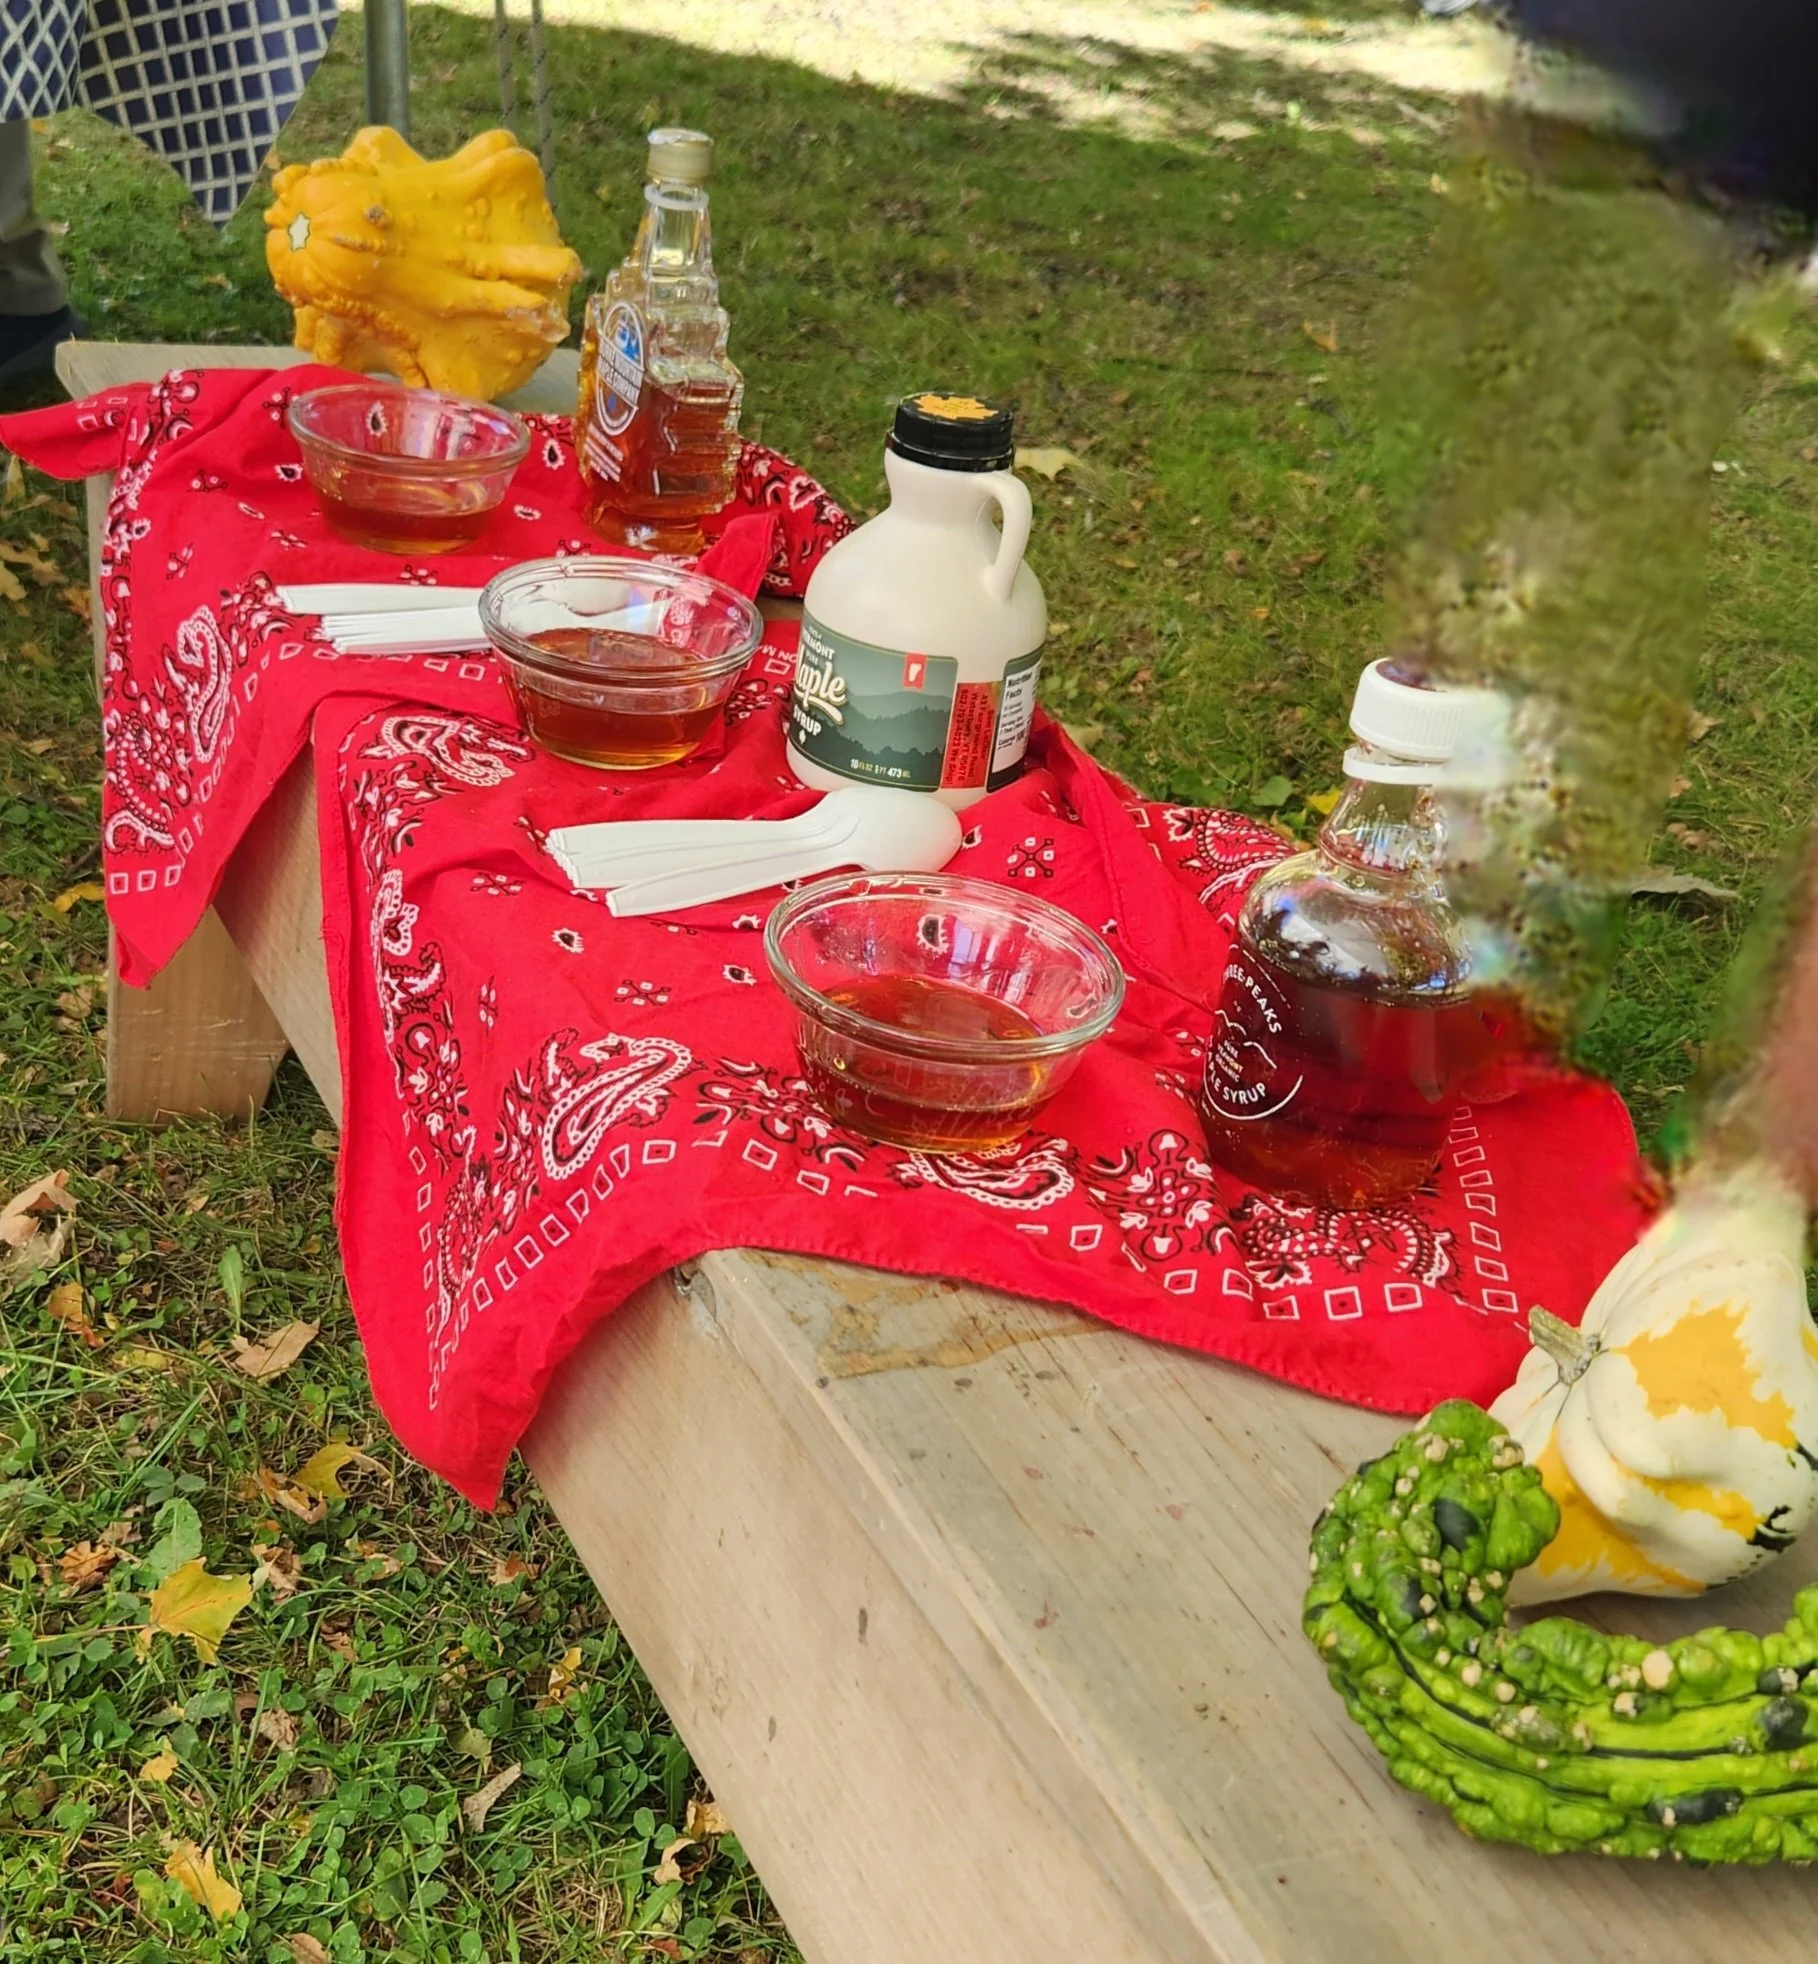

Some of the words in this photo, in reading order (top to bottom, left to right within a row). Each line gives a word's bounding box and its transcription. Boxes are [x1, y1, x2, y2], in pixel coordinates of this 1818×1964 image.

[803, 628, 835, 660] ERMONT
[887, 766, 903, 779] 473
[1245, 976, 1282, 1033] PEAKS
[1223, 1082, 1266, 1105] SYRUP
